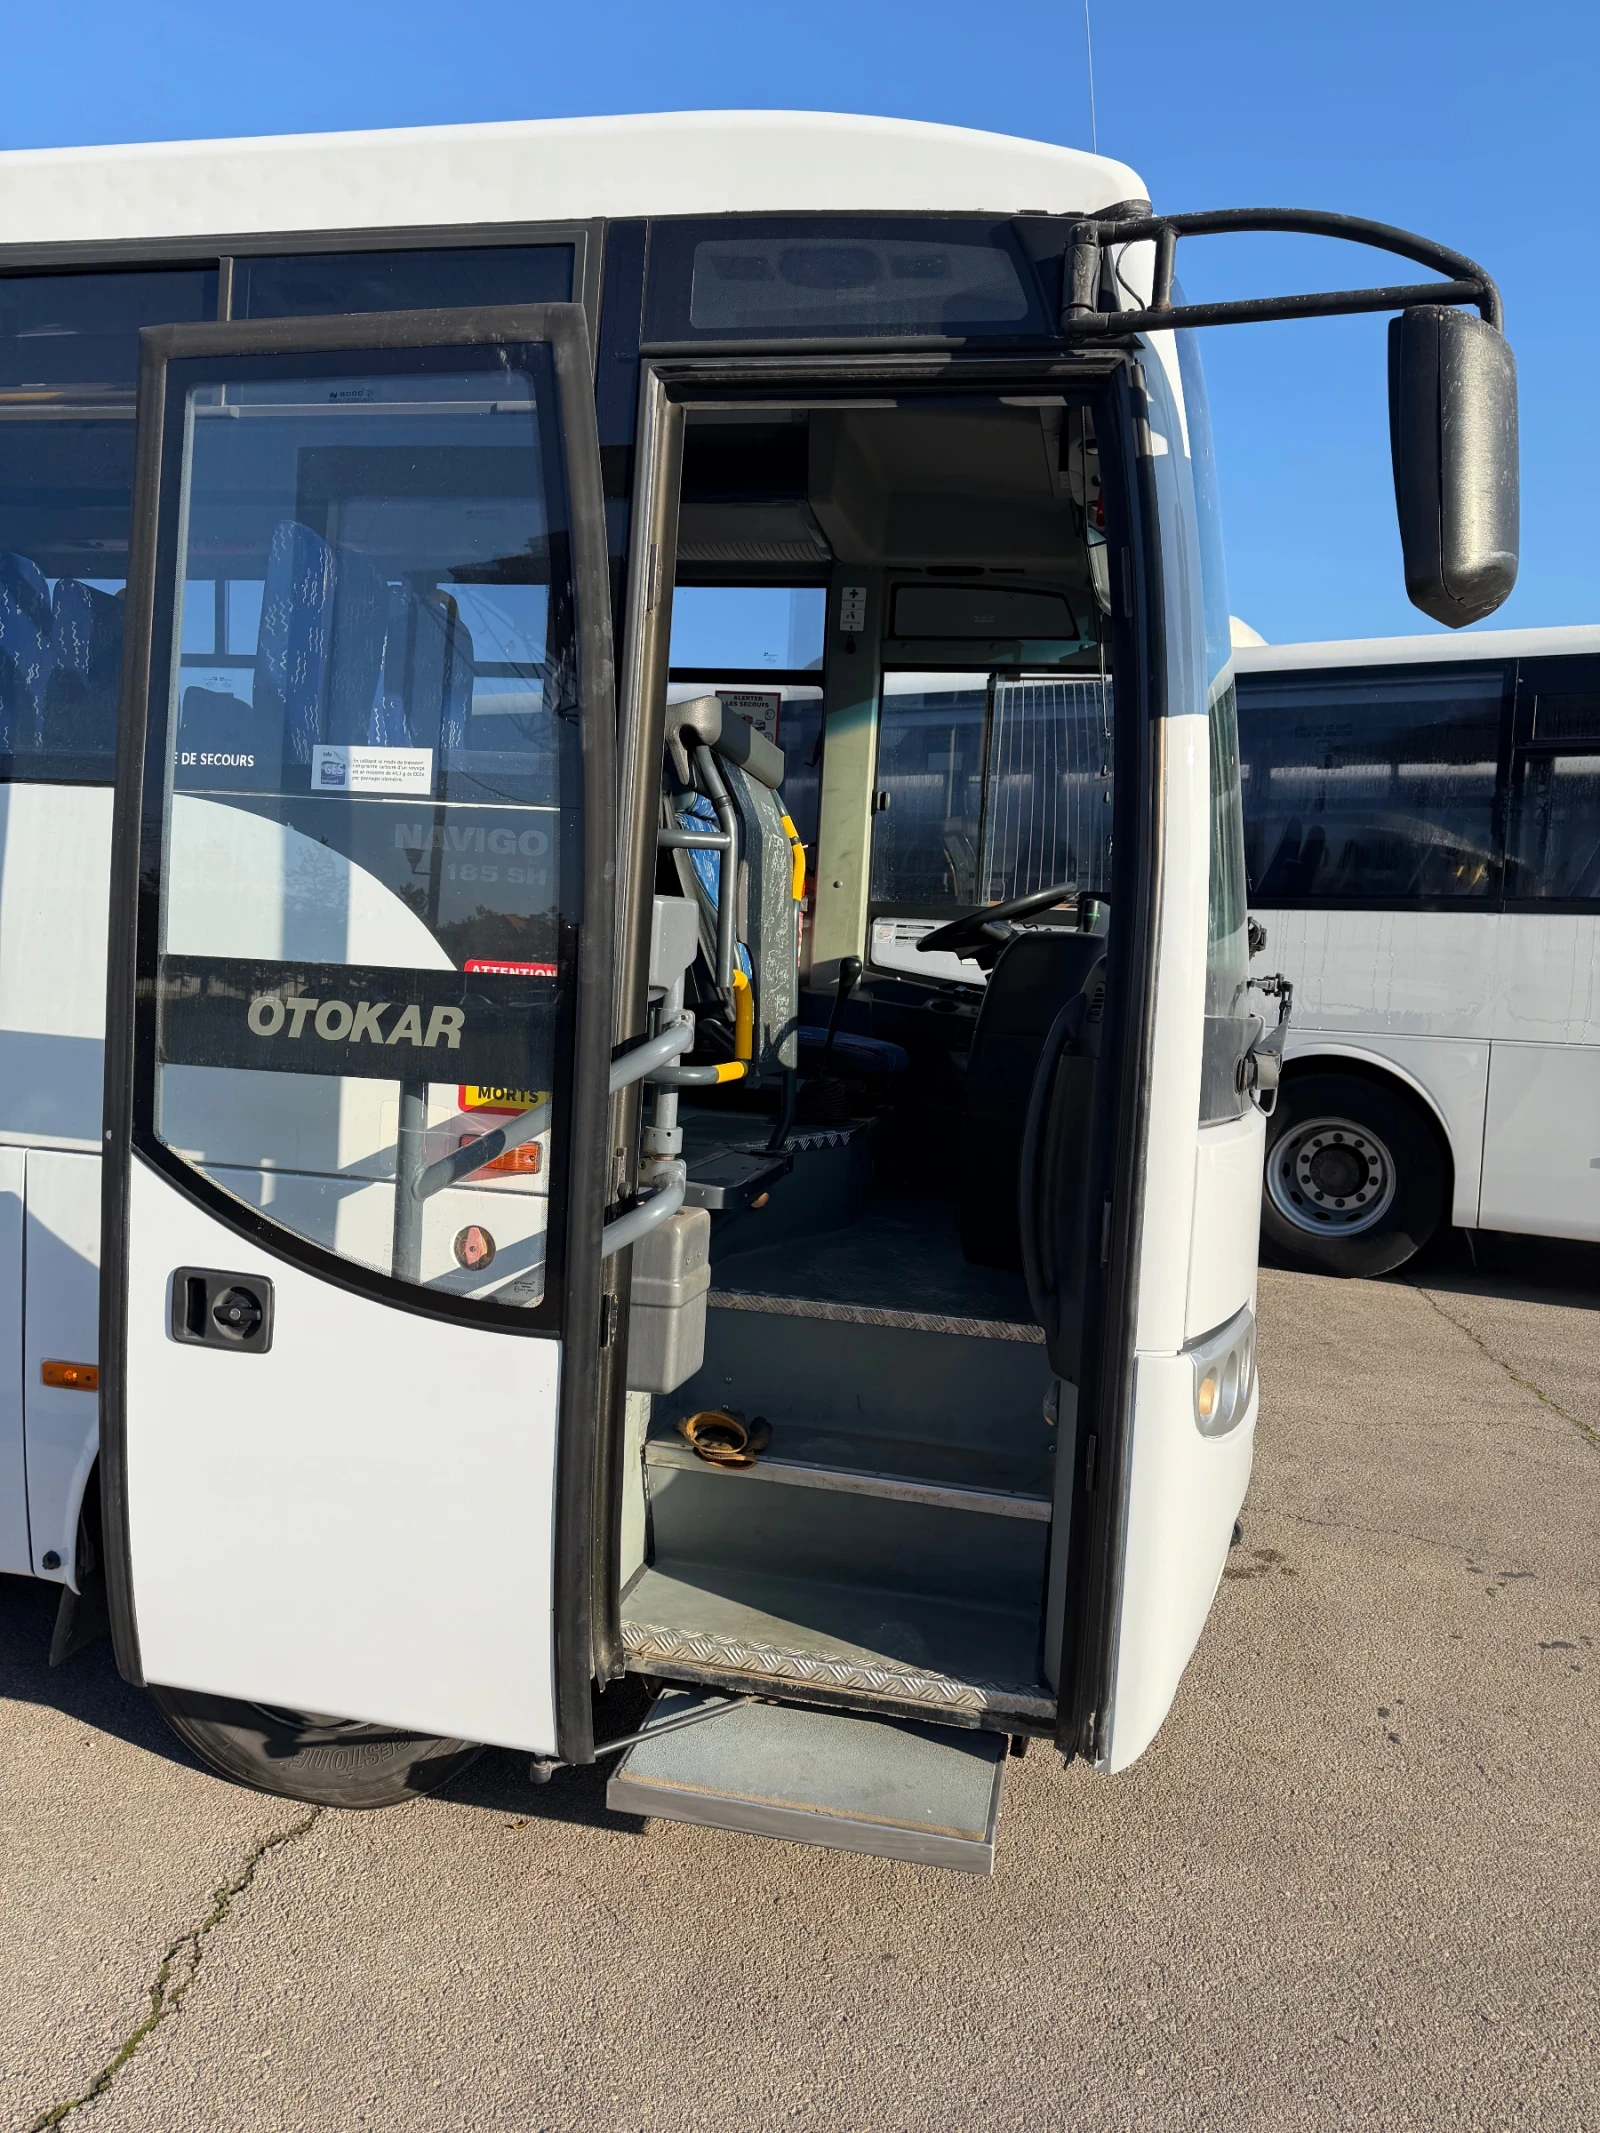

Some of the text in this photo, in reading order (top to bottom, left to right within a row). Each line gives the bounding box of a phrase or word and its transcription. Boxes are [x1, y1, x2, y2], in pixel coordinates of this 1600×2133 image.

[181, 752, 197, 765] DE
[200, 753, 255, 767] SECOURS
[324, 764, 345, 775] GES
[395, 823, 549, 857] NAVIGO
[447, 863, 548, 885] 185 SH
[247, 996, 466, 1049] OTOKAR
[477, 1085, 539, 1104] MORTS
